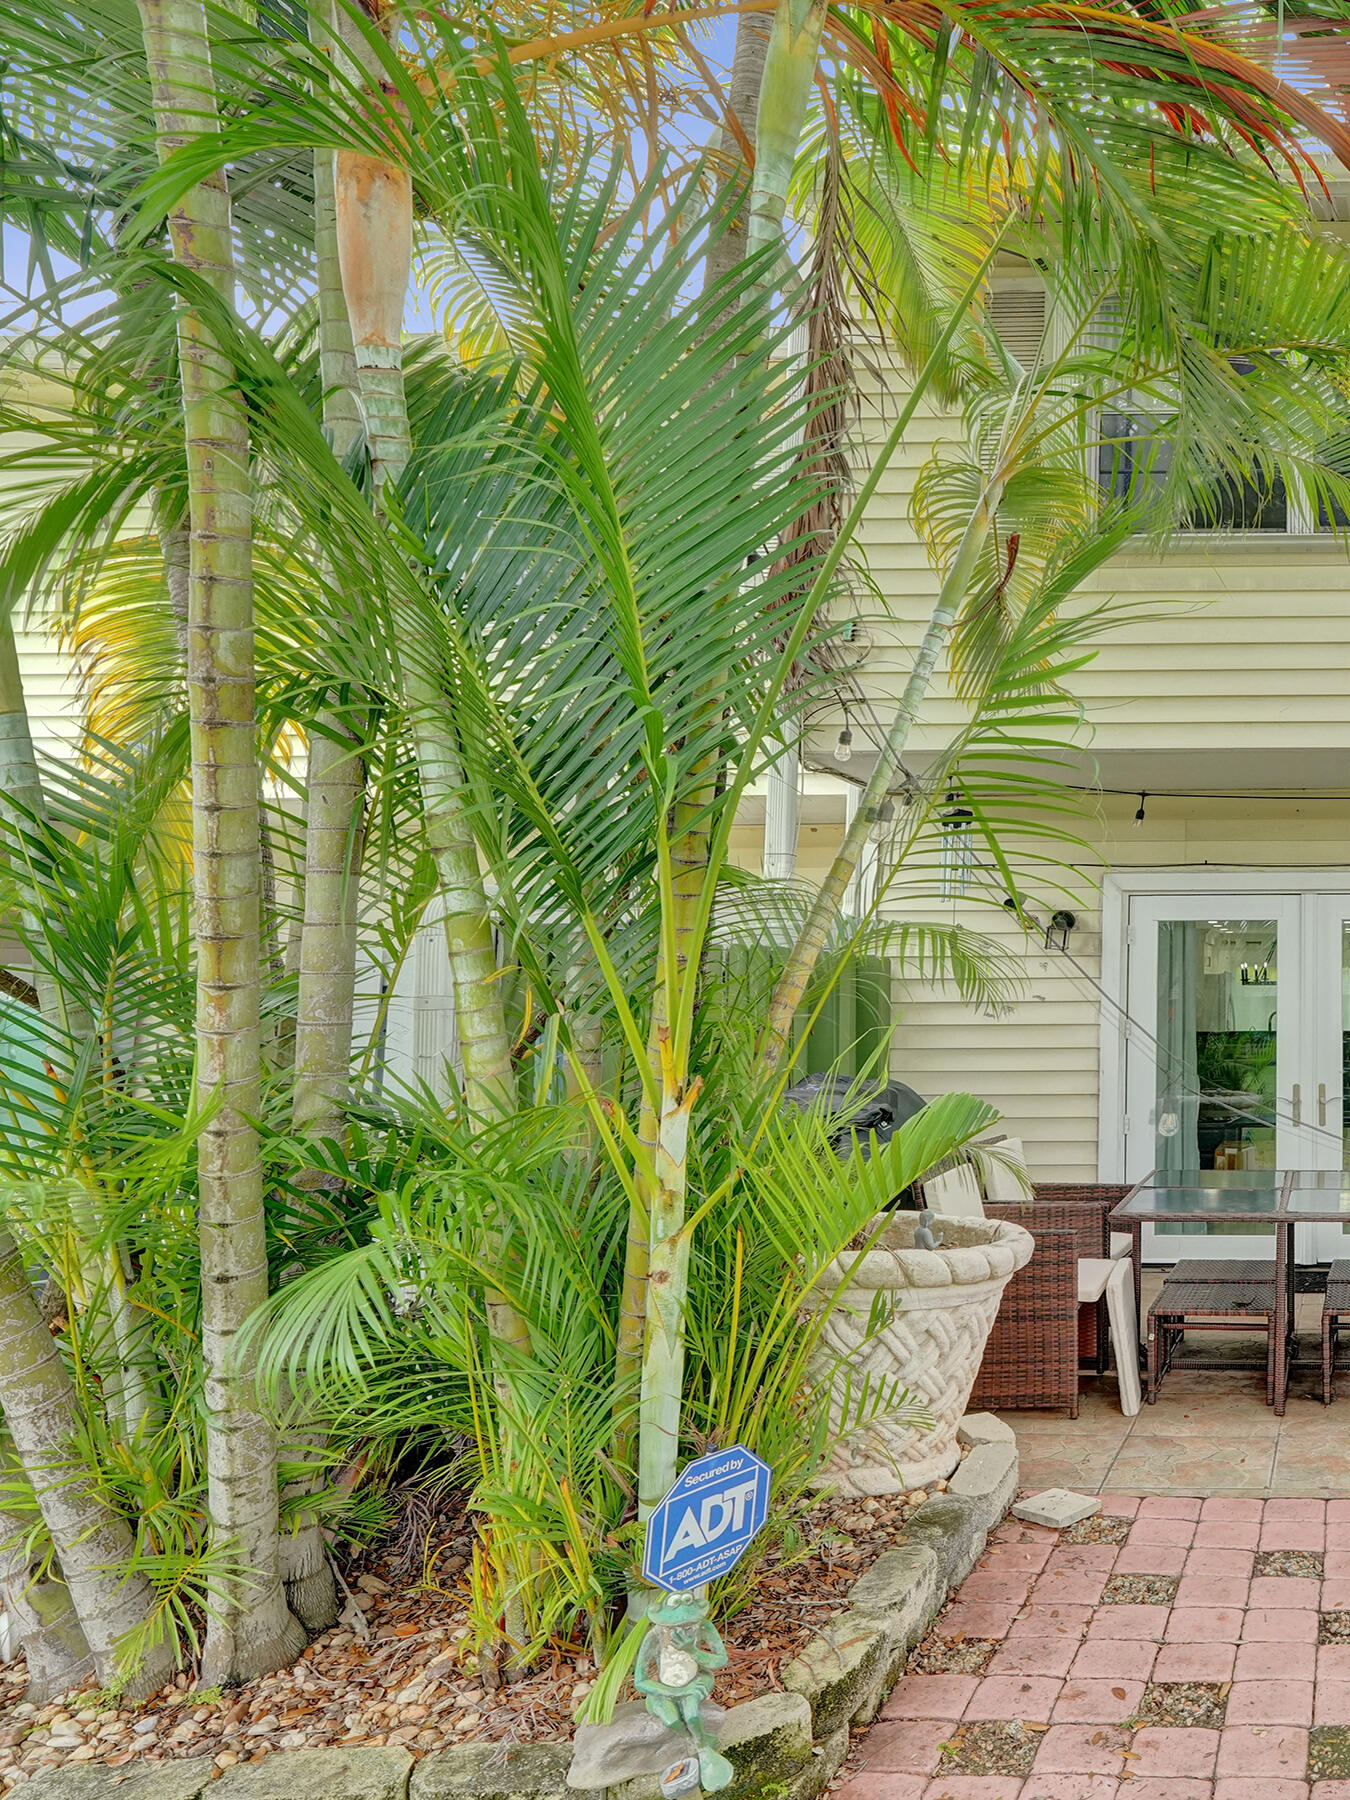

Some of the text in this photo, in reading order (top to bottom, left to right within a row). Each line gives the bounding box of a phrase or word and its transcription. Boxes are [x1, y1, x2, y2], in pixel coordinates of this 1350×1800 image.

[684, 1457, 745, 1488] Secured by
[663, 1479, 758, 1563] ADT
[668, 1543, 744, 1584] 1-800-ADT-ASAP
